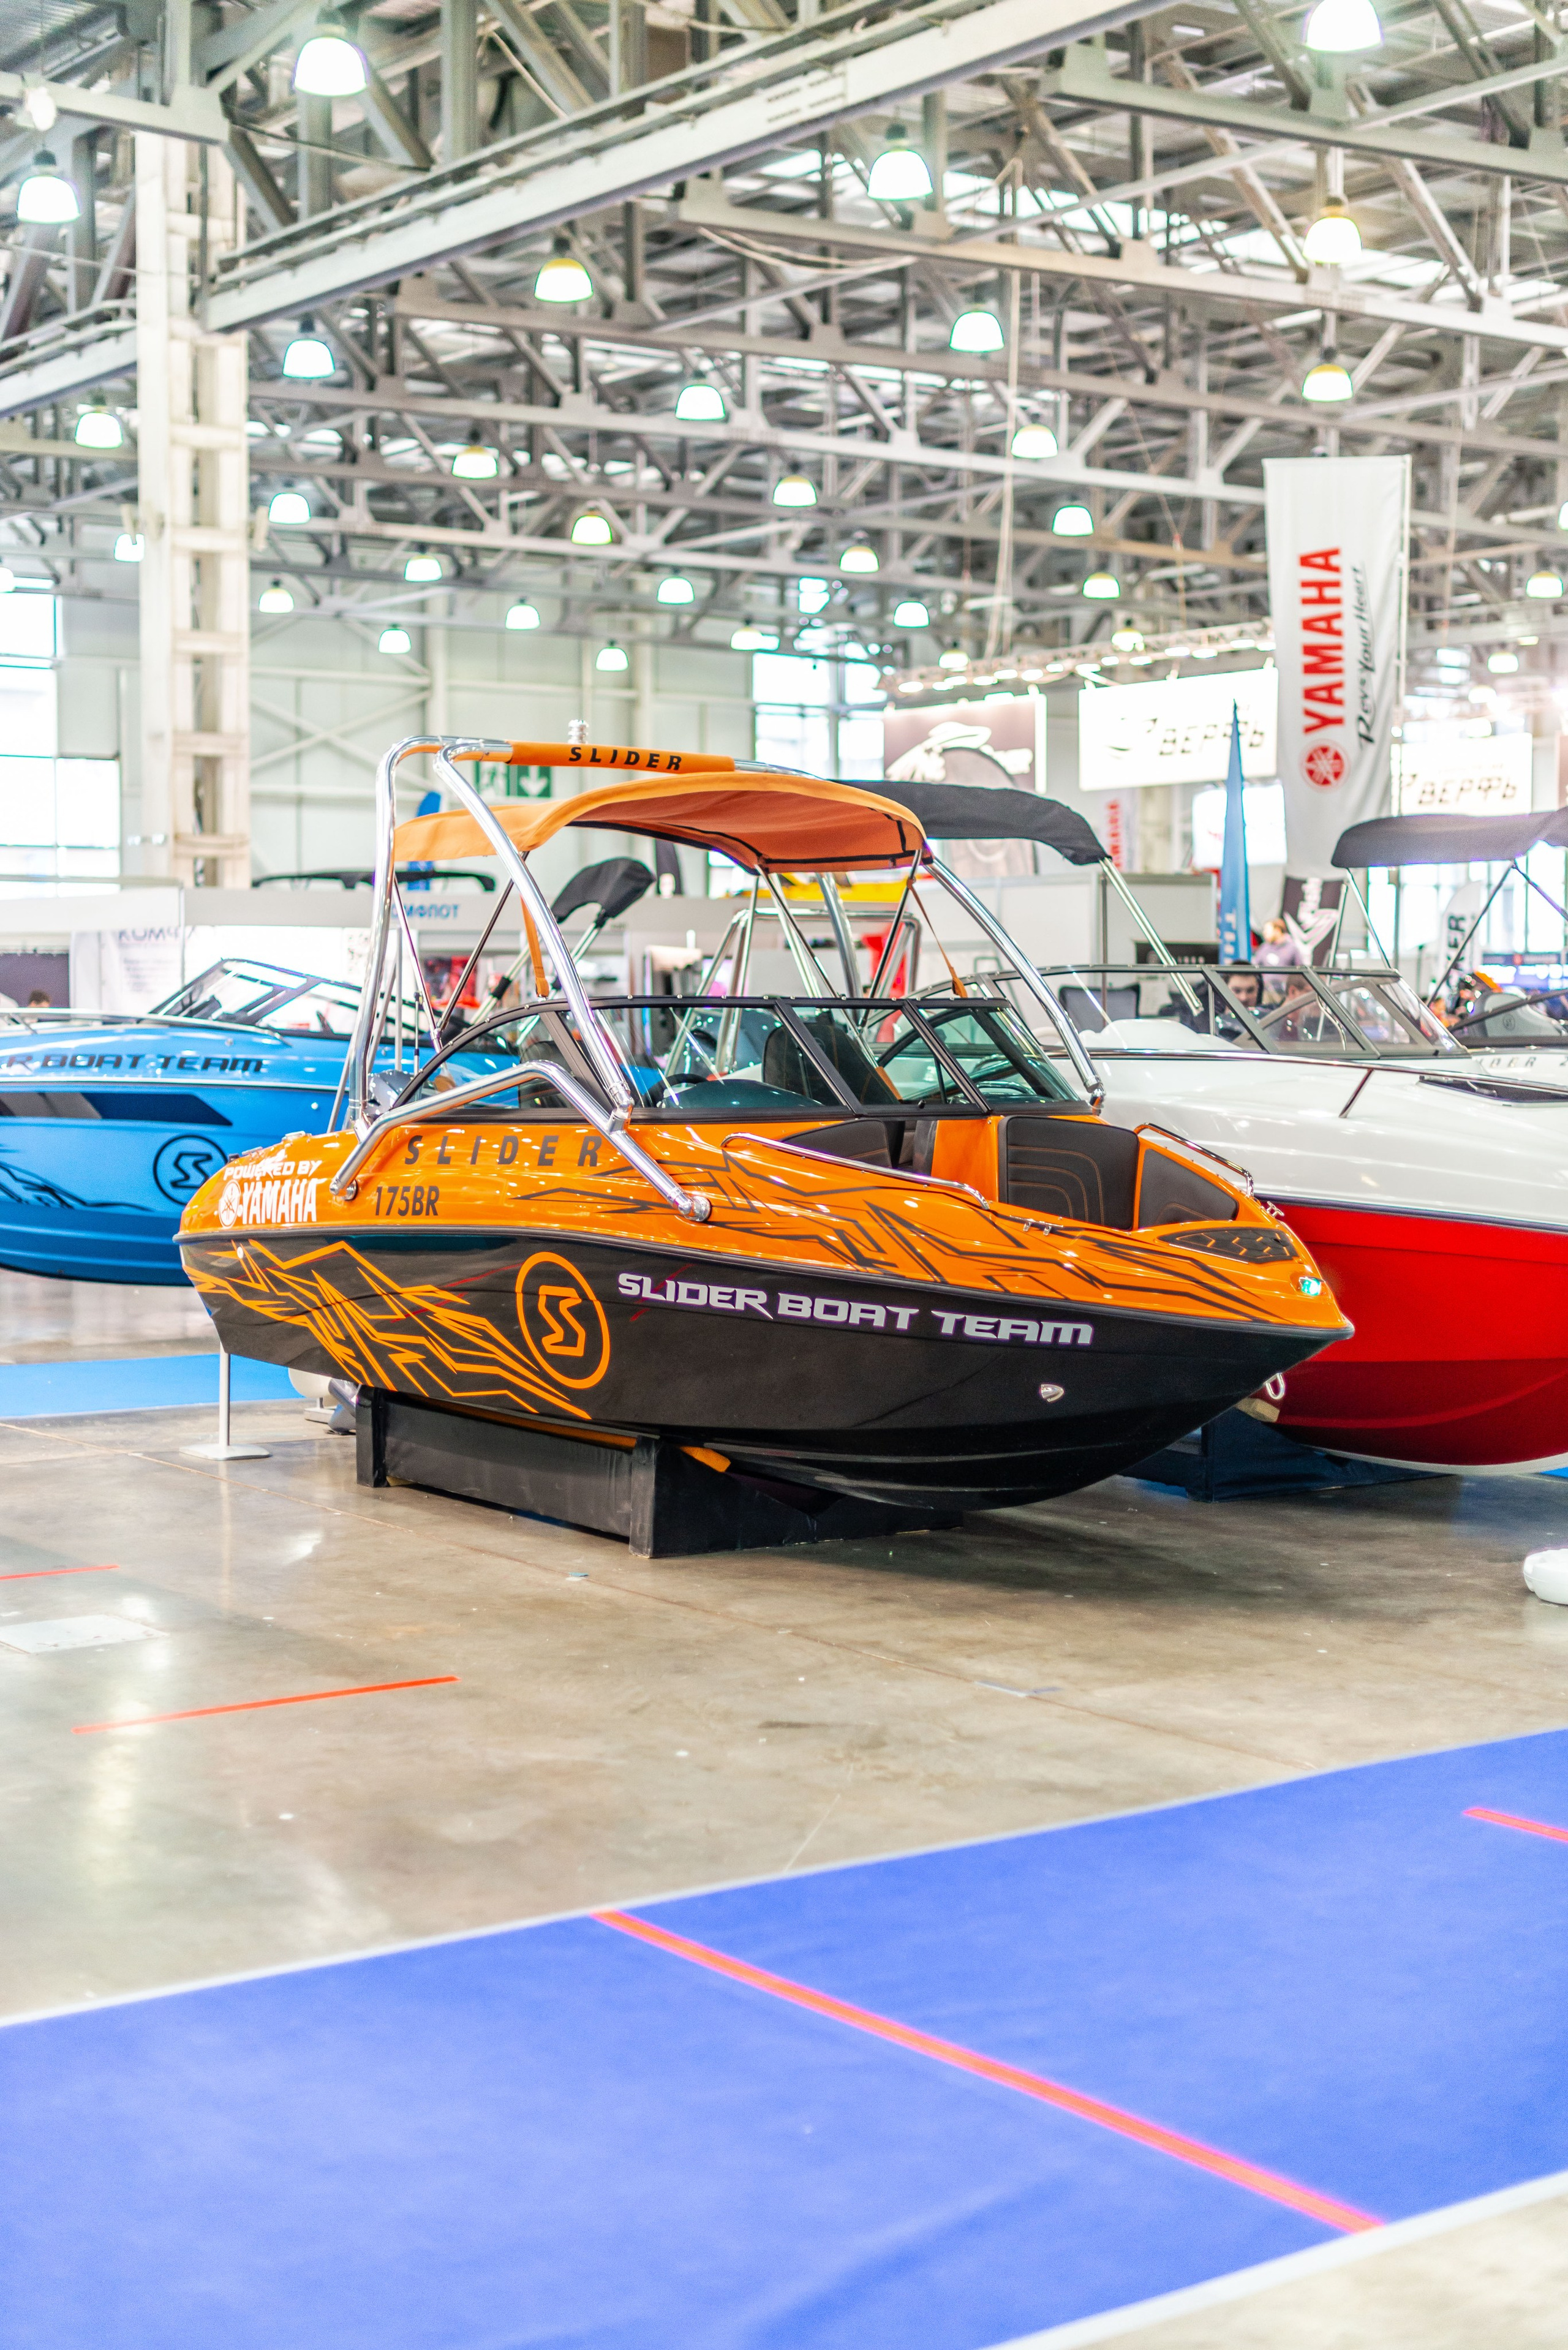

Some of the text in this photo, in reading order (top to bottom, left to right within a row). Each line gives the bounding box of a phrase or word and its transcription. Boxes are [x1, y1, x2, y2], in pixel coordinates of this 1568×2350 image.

[1299, 548, 1344, 734] YAMAHA
[1357, 625, 1375, 673] Your
[1356, 677, 1375, 748] Revs
[568, 746, 682, 770] SLIDER
[41, 1053, 145, 1069] BOAT
[158, 1053, 263, 1072] TEAM
[224, 1160, 323, 1181] POWERED BY
[404, 1135, 603, 1167] SLIDER
[243, 1178, 317, 1224] YAMAHA
[374, 1186, 439, 1217] 175BR
[617, 1272, 1094, 1347] SLIDER BOAT TEAM
